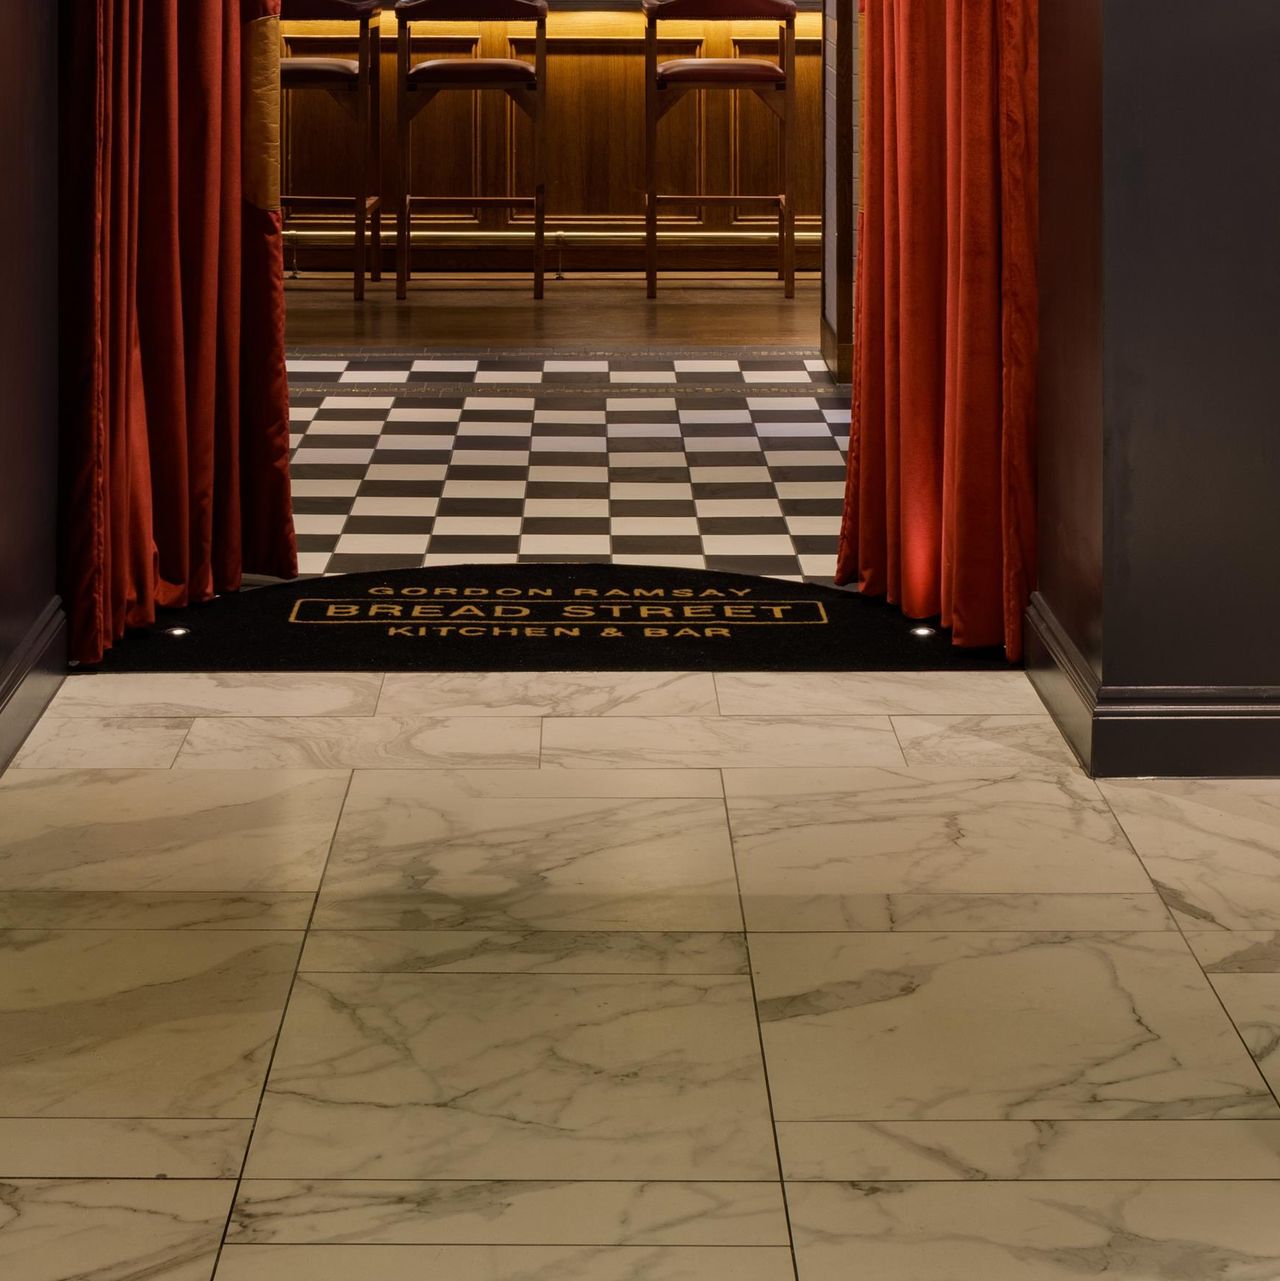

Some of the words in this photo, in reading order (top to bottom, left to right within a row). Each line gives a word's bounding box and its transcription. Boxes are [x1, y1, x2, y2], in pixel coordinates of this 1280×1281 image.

[368, 587, 553, 597] GORDON
[574, 588, 752, 598] RAMSAY
[326, 604, 531, 618] BREAD
[562, 605, 792, 619] STREET
[388, 626, 581, 637] KITCHEN
[600, 627, 624, 638] &
[643, 627, 732, 638] BAR
